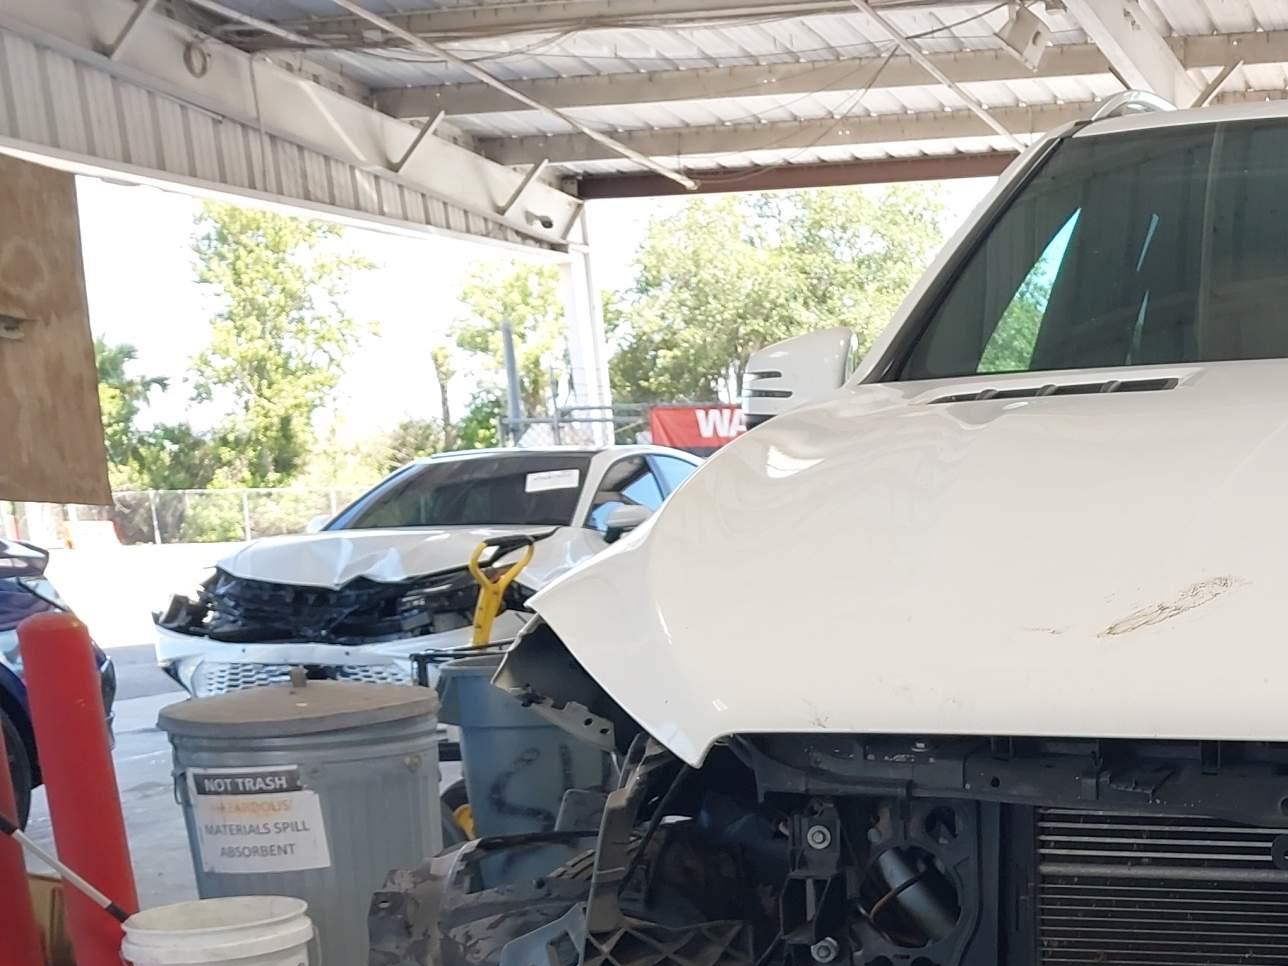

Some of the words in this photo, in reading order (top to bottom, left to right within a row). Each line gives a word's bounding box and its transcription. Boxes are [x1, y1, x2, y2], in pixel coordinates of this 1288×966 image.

[204, 778, 233, 792] NOT
[235, 776, 287, 790] TRASH
[204, 822, 271, 836] MATERIALS
[273, 820, 310, 833] SPILL
[220, 843, 296, 858] ABSORBENT
